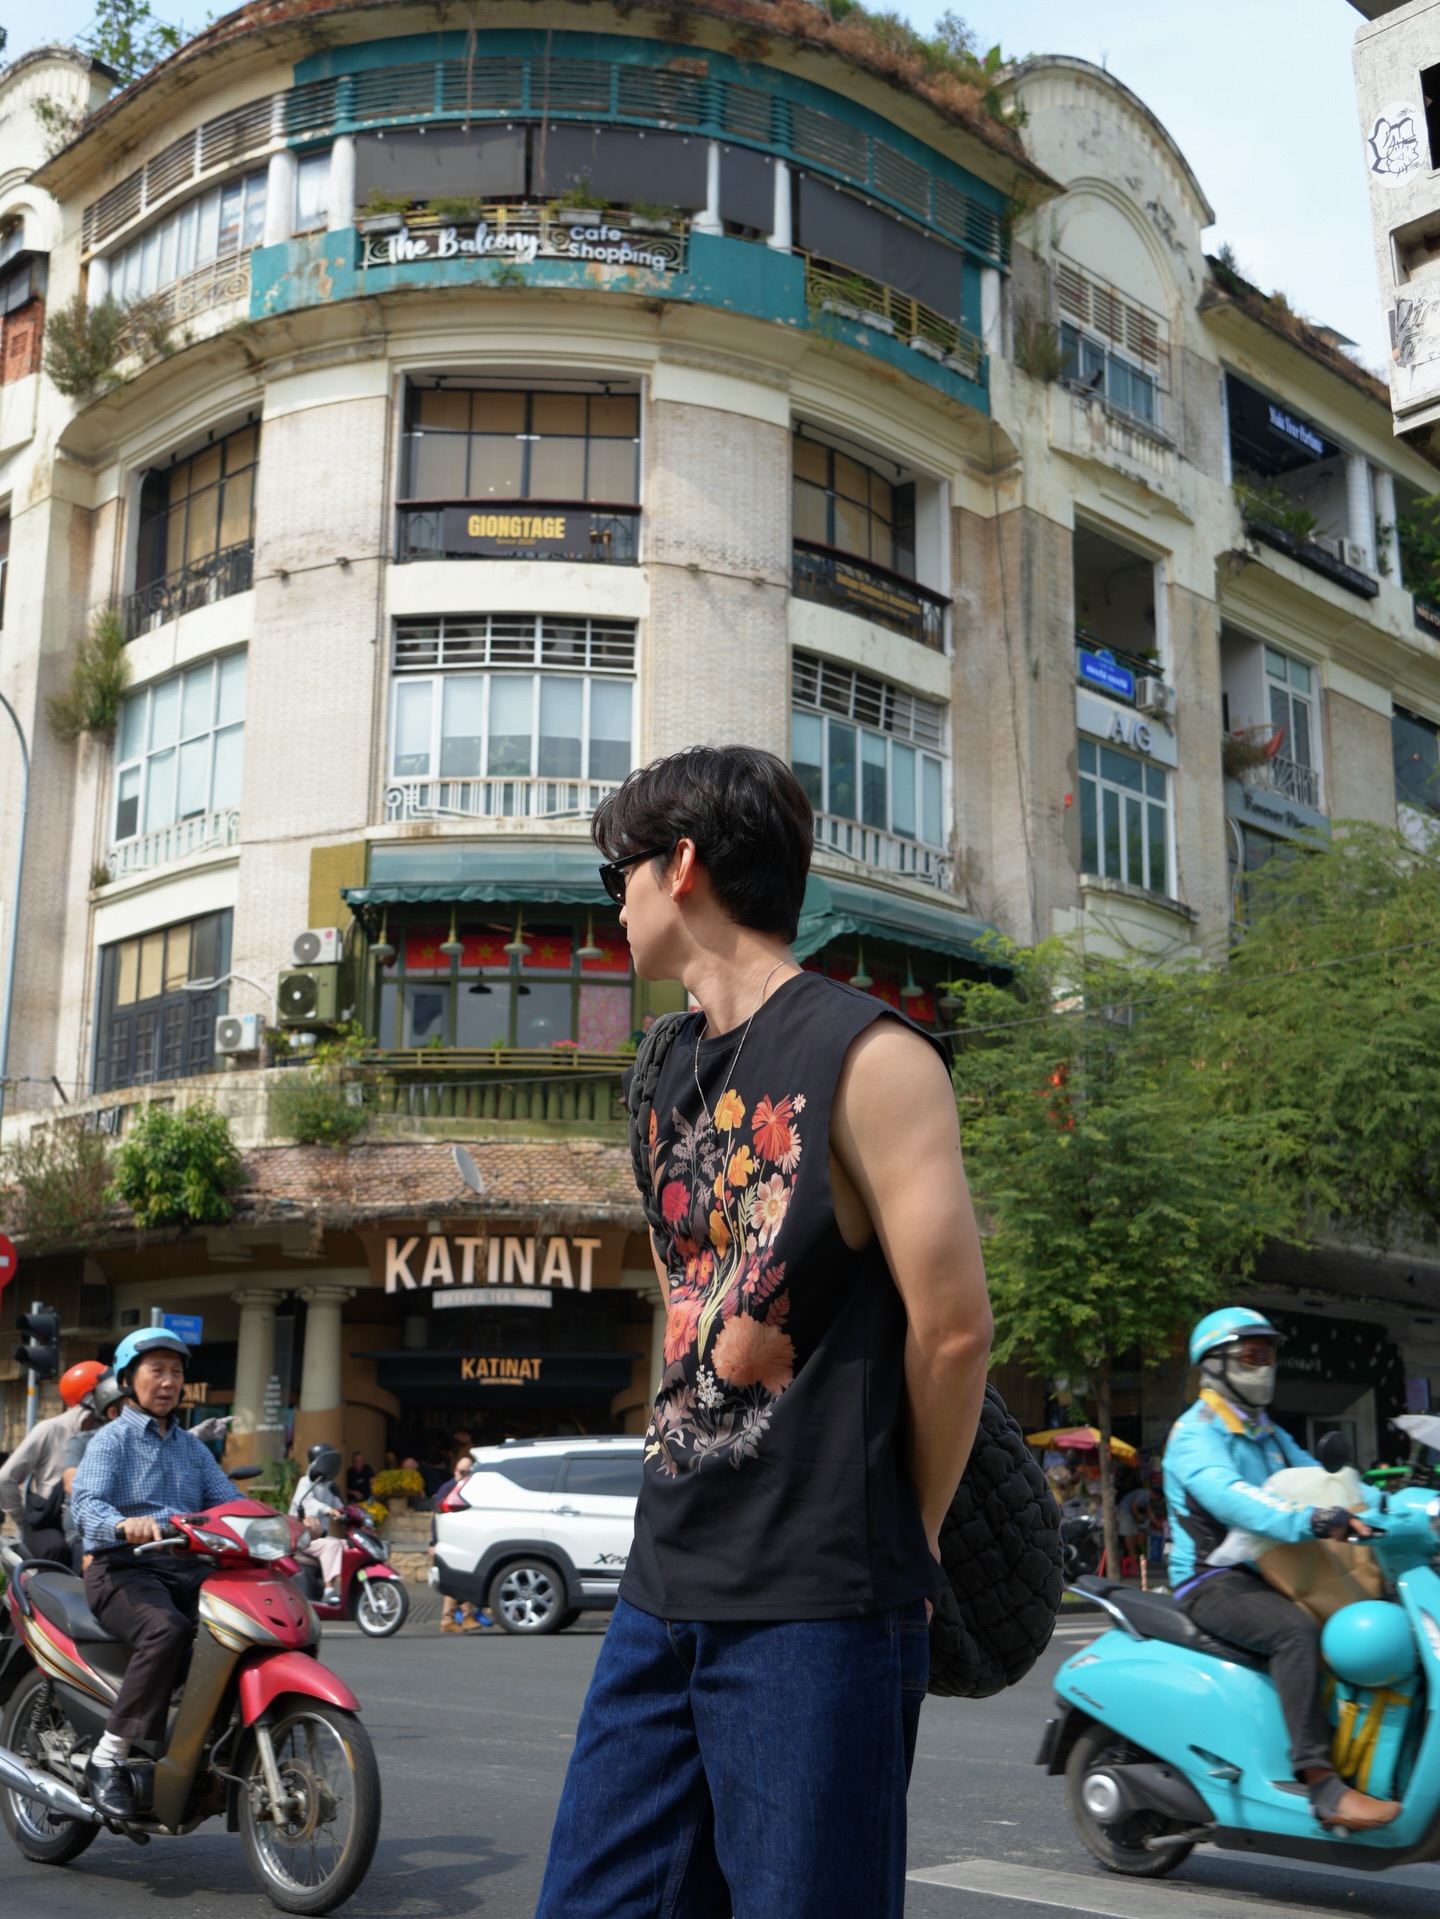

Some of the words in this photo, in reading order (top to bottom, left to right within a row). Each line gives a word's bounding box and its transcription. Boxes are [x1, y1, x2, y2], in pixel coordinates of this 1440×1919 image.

[387, 226, 430, 264] The
[434, 222, 541, 261] Balcony
[570, 226, 622, 242] Cafe
[567, 241, 667, 272] Shopping
[385, 1236, 601, 1293] KATINAT
[461, 1357, 543, 1380] KATINAT
[592, 1553, 628, 1565] XPA
